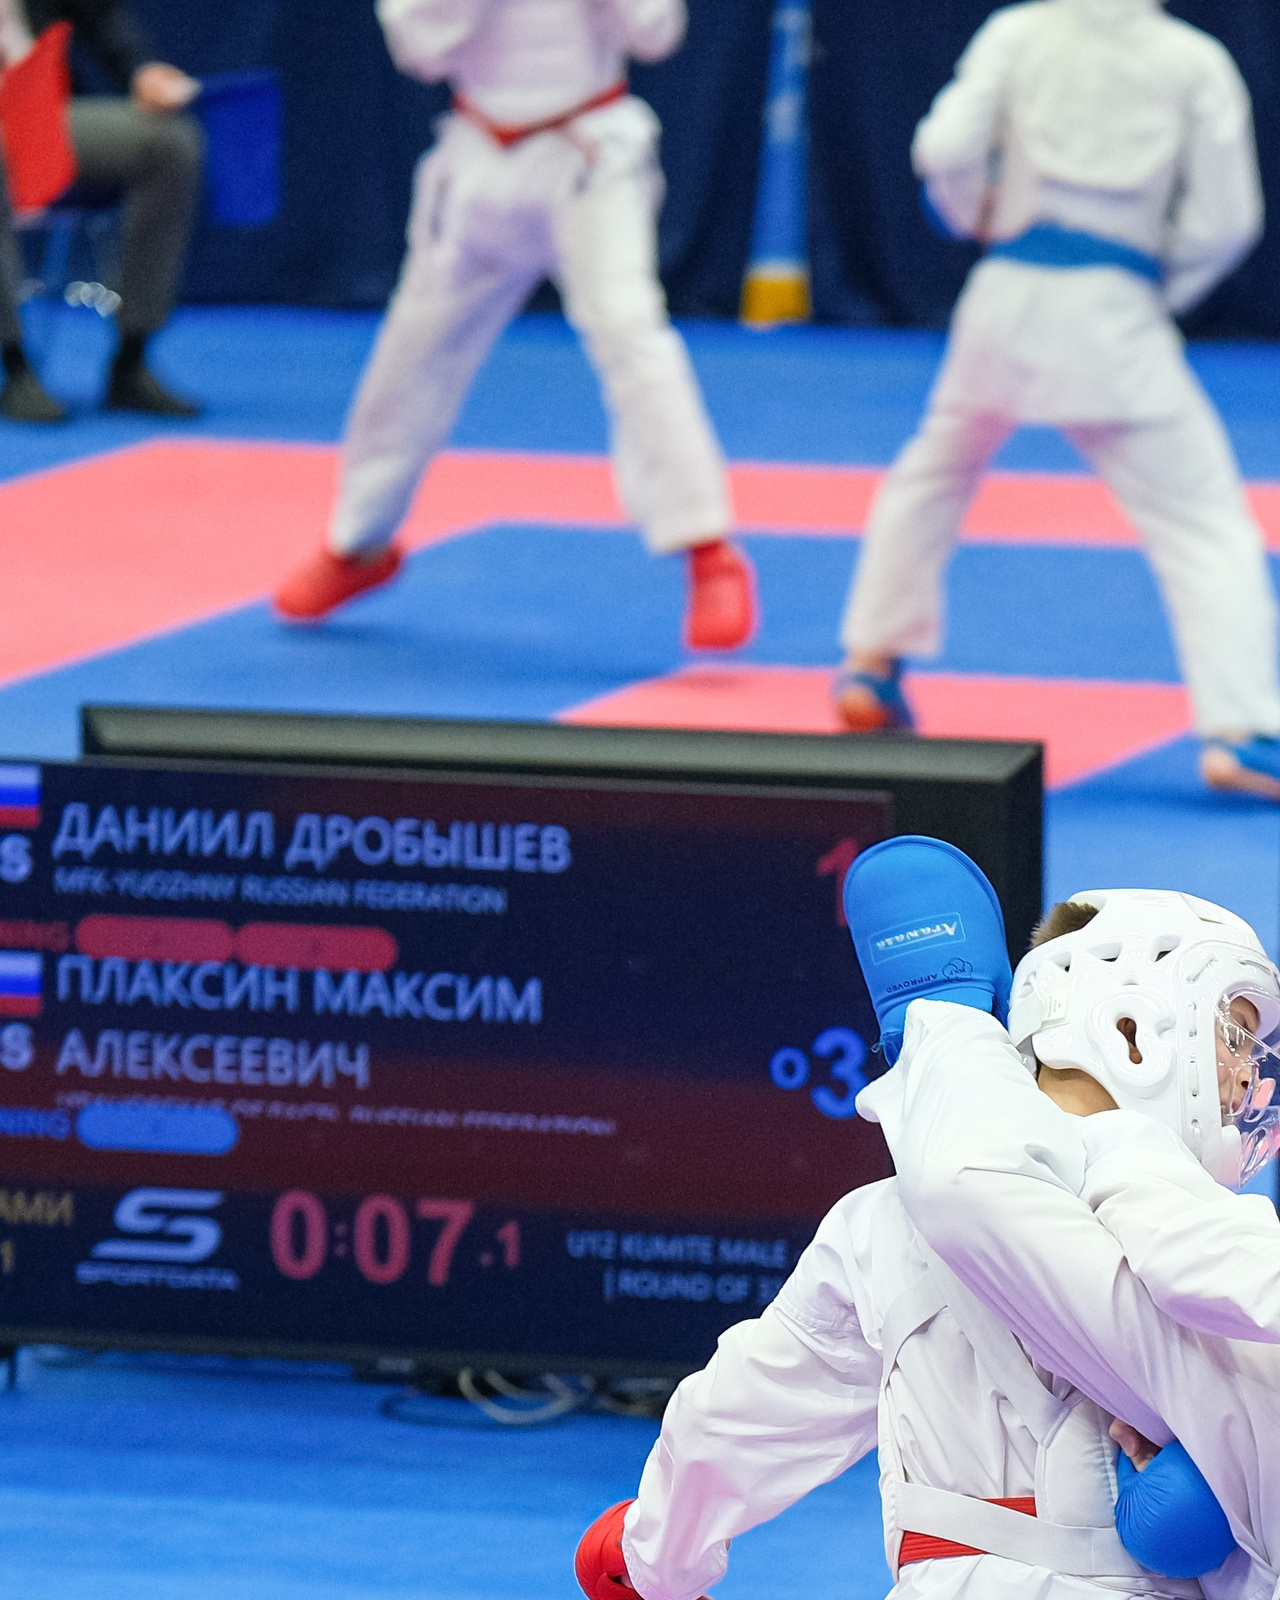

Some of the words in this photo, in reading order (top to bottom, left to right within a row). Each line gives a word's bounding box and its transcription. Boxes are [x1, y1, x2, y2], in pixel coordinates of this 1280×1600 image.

[52, 801, 276, 862] ДАНИИЛ
[284, 811, 573, 874] ДРОБЫШЕВ
[353, 878, 509, 915] FEDERATION
[56, 954, 298, 1013] ПЛАКСИН
[312, 967, 545, 1024] МАКСИМ
[885, 972, 938, 994] APPROVED
[55, 1028, 371, 1089] АЛЕКСЕЕВИЧ
[809, 1026, 868, 1119] 3
[620, 1232, 714, 1266] KUMITE
[717, 1238, 788, 1269] MALE
